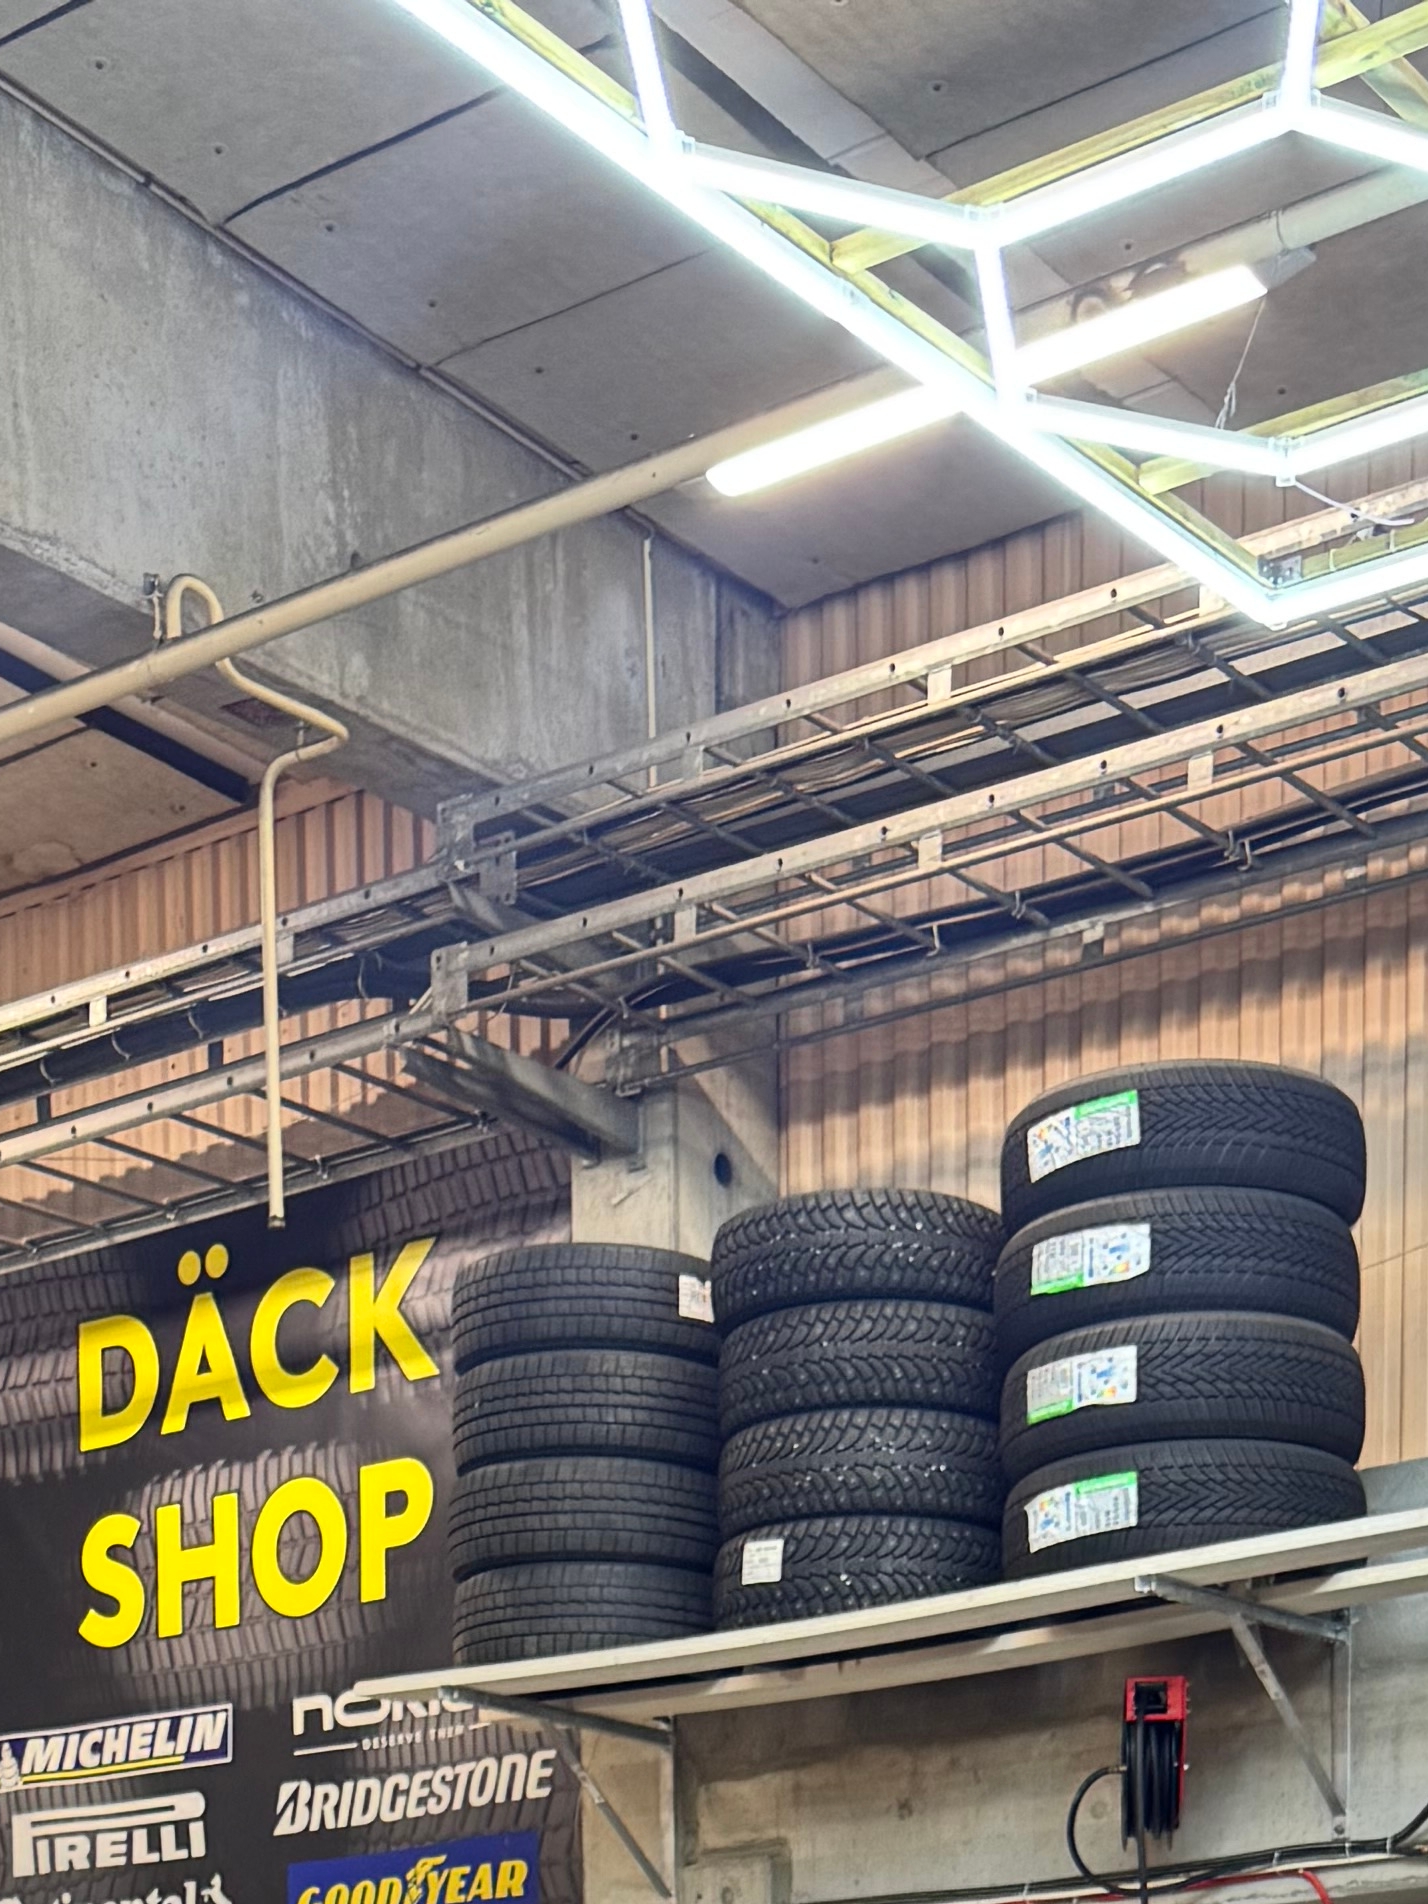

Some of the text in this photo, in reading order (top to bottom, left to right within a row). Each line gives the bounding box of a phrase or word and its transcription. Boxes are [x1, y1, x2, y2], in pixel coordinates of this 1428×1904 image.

[79, 1238, 441, 1452] DÄCK
[78, 1457, 435, 1648] SHOP
[21, 1712, 227, 1776] MICHELIN
[11, 1791, 206, 1878] PIRELLI
[273, 1749, 557, 1836] BRIDGESTONE
